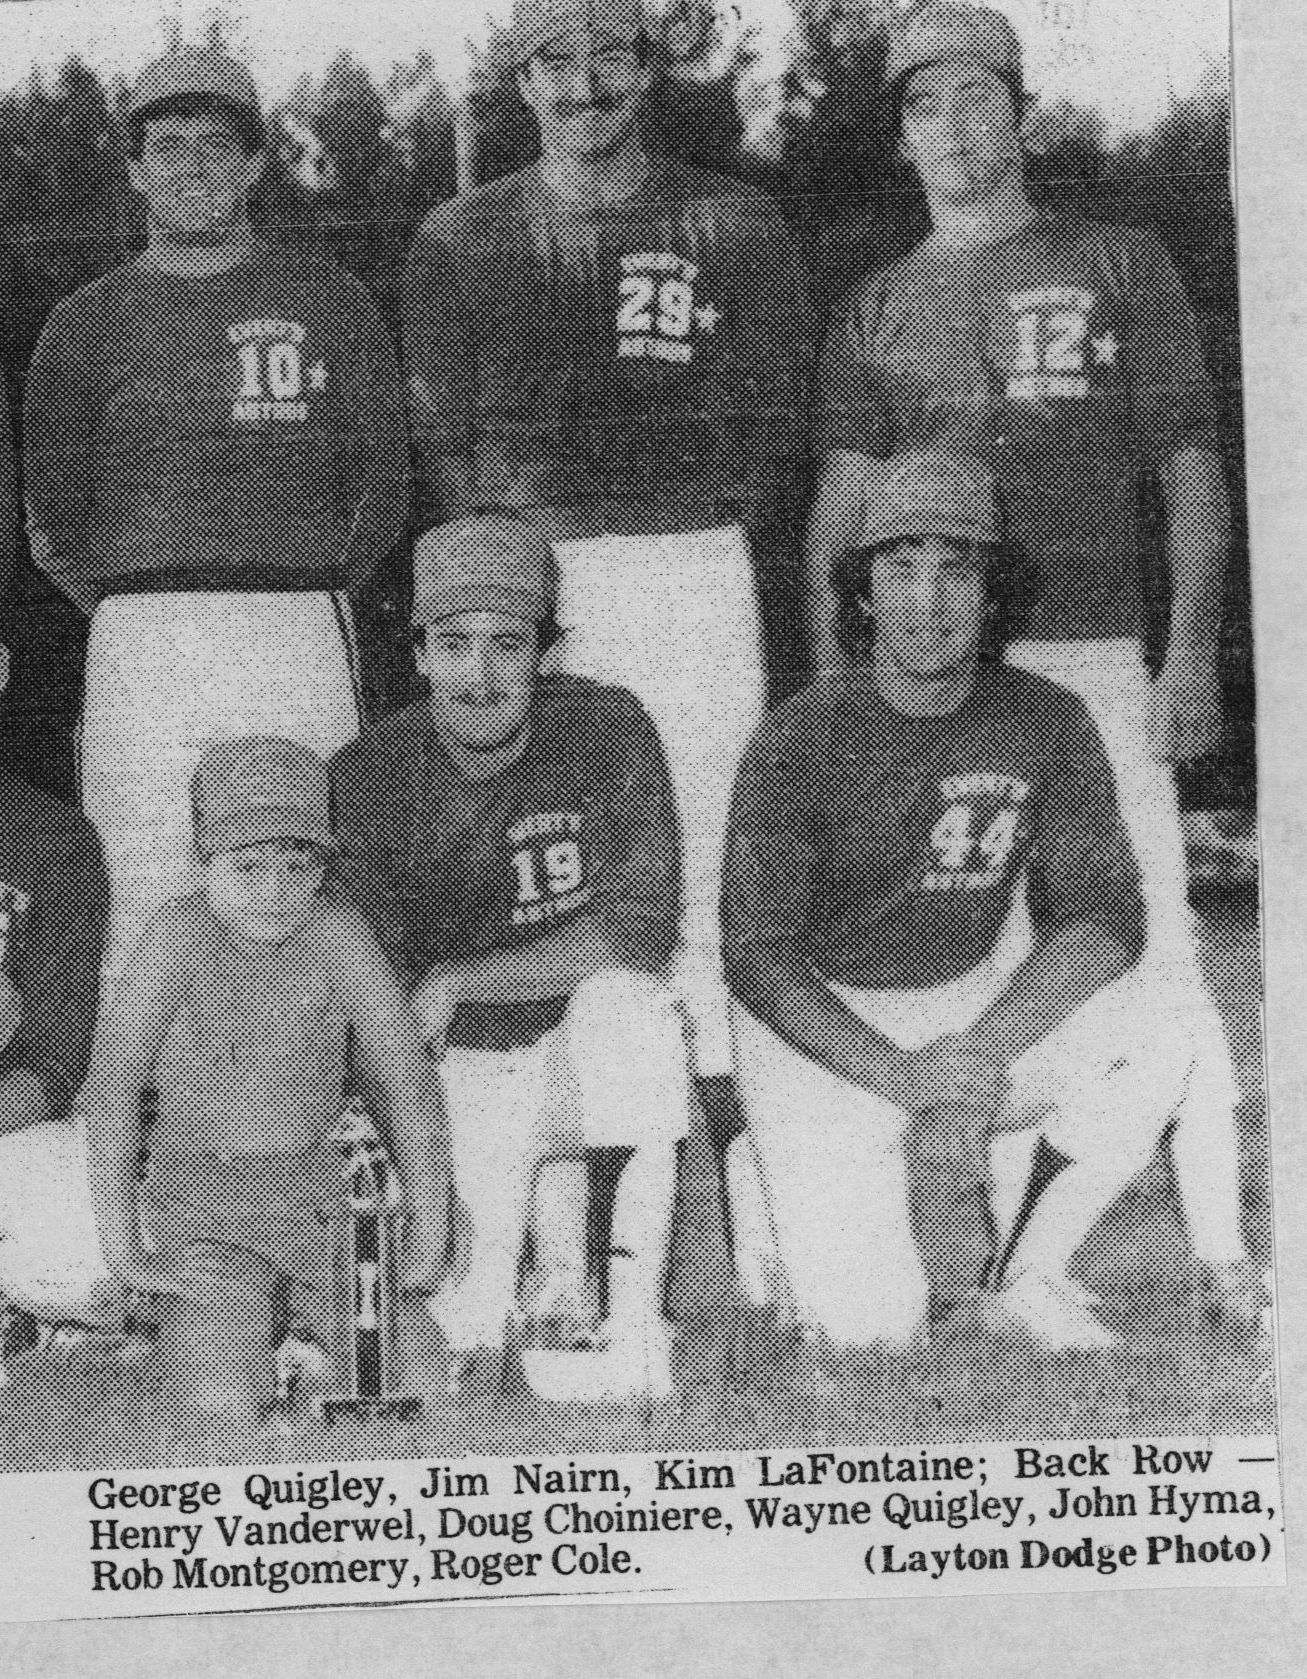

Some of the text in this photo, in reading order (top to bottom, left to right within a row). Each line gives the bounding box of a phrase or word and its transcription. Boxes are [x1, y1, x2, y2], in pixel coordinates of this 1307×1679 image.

[616, 275, 694, 338] 29
[238, 343, 301, 400] 10
[1016, 312, 1087, 371] 12
[931, 804, 1018, 868] 44
[512, 841, 583, 902] 19
[88, 1478, 221, 1515] George
[244, 1469, 397, 1511] Quigley,
[419, 1467, 489, 1499] Jim
[513, 1463, 631, 1498] Nairn,
[655, 1459, 735, 1491] Kim
[758, 1452, 987, 1487] LaFontaine;
[1014, 1444, 1110, 1479] Back
[1132, 1444, 1213, 1475] Row
[89, 1484, 1275, 1556] Henry Vanderwel, Doug Choiniere, Wayne Quigley, John Hyma,
[91, 1542, 643, 1594] Rob Montgomery, Roger Cole.
[864, 1533, 1271, 1580] (Layton Dodge Photo)
